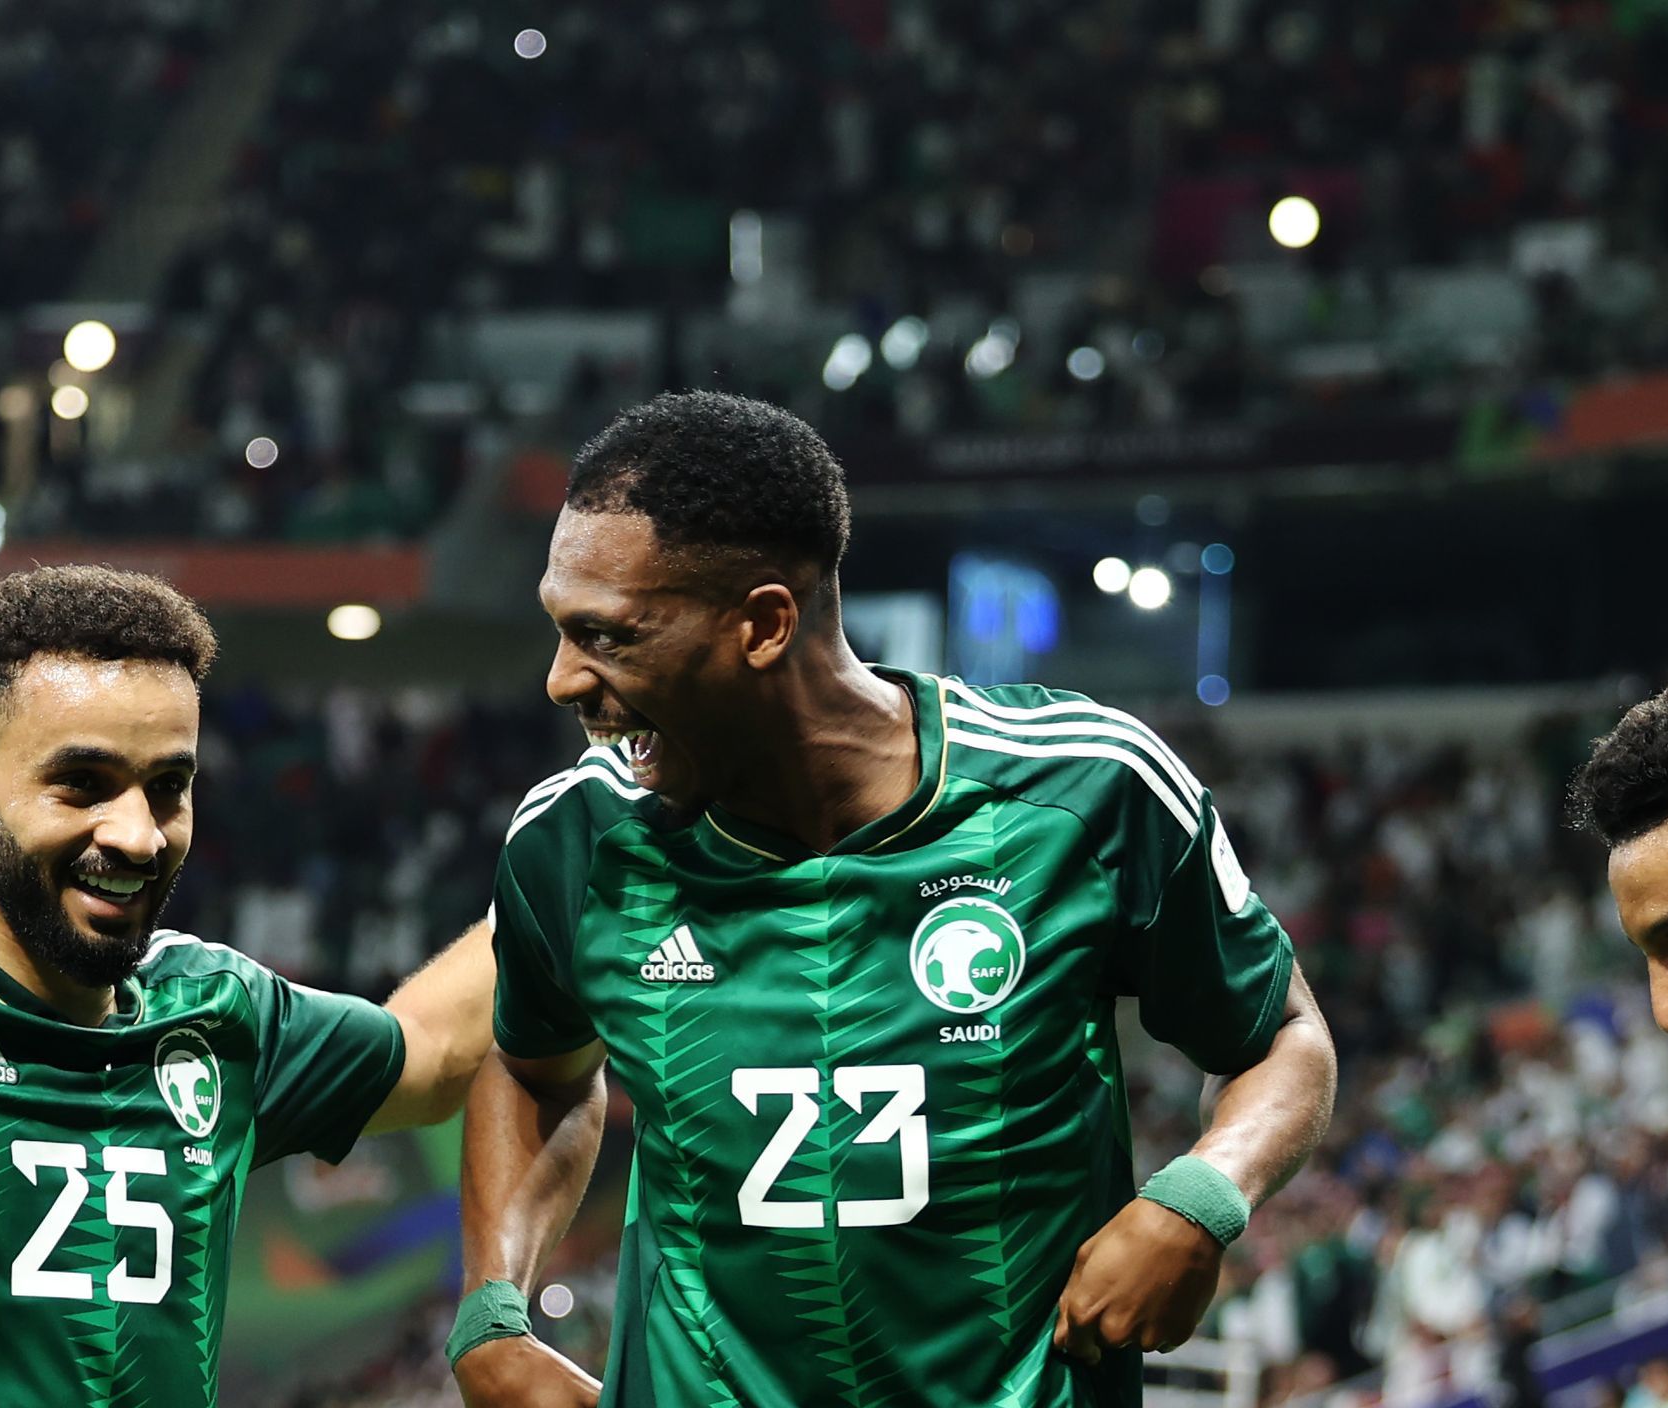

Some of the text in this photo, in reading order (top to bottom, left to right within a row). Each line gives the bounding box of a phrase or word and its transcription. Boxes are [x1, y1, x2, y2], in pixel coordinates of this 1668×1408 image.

[918, 875, 1012, 897] السعودية
[641, 961, 715, 982] adidas
[971, 966, 1005, 979] SAFF
[939, 1024, 1001, 1043] SAUDI
[195, 1094, 213, 1106] SAFF
[732, 1064, 930, 1227] 23
[183, 1146, 213, 1166] SAUDI
[11, 1140, 174, 1304] 25
